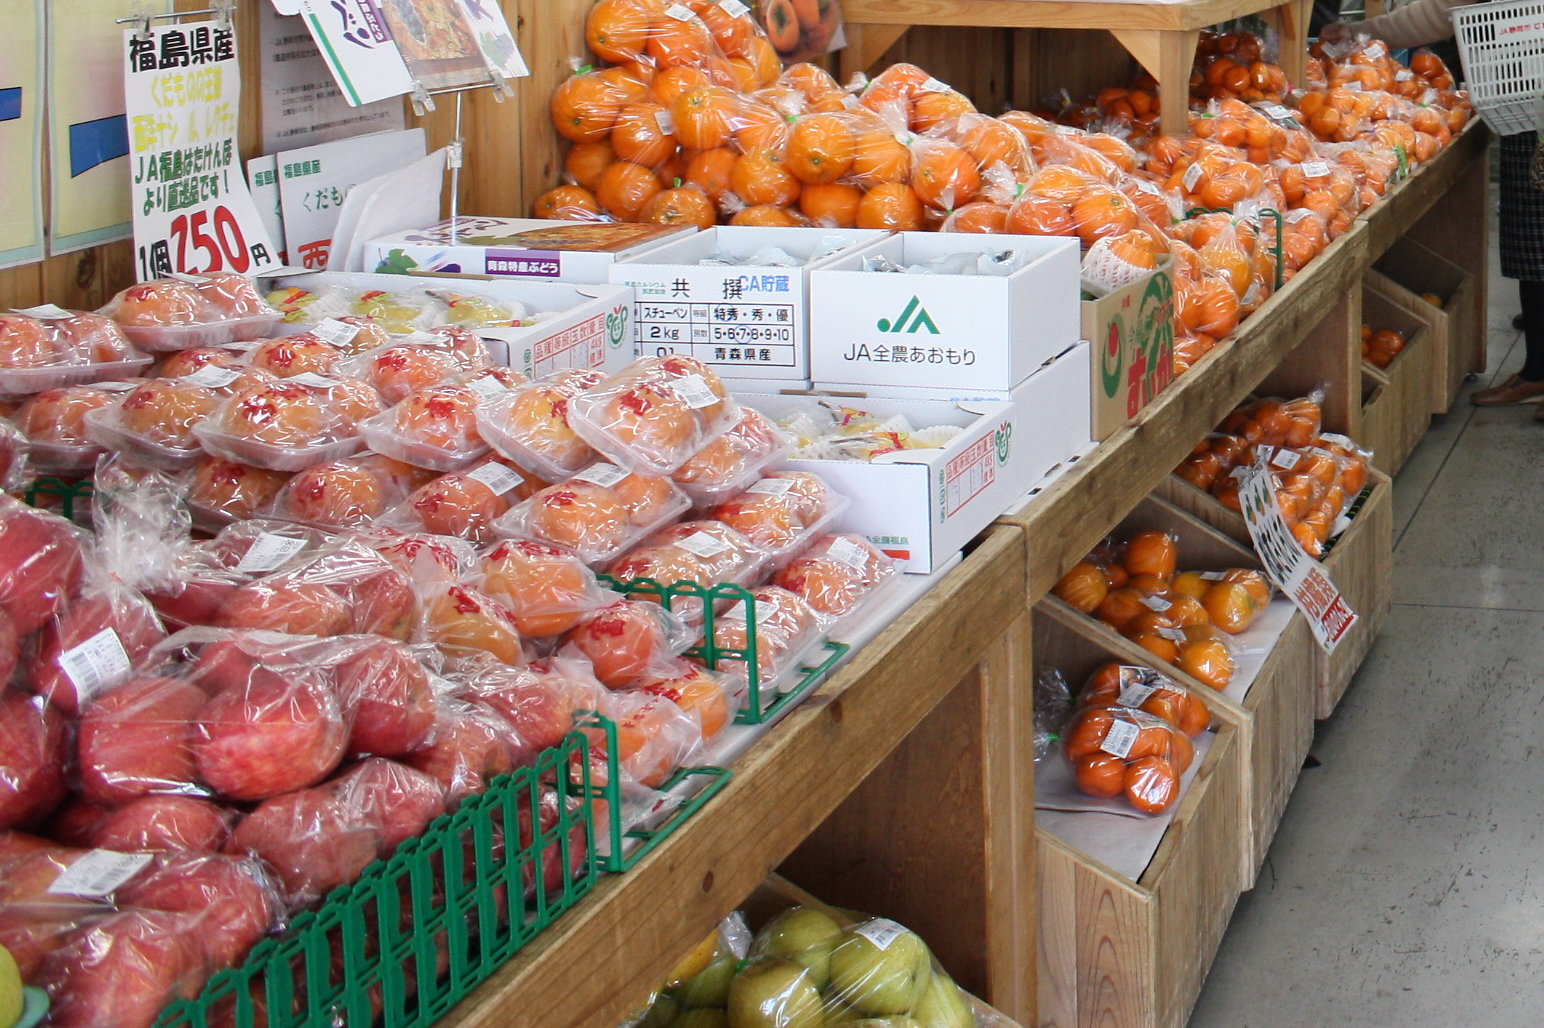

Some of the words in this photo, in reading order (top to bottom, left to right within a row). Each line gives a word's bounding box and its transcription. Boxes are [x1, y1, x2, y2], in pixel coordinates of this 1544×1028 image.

[130, 26, 234, 72] 福島県産
[284, 160, 321, 179] 福島県産
[303, 183, 356, 212] くだも
[171, 205, 250, 275] 250
[250, 243, 271, 267] 円
[487, 260, 558, 274] 青森特産ぶどう
[671, 278, 690, 298] 共
[738, 275, 789, 292] CA貯蔵
[644, 307, 687, 319] スチューベン
[651, 327, 660, 338] 2
[664, 327, 679, 340] kg
[715, 348, 771, 361] 青森県産
[843, 343, 976, 366] JA全農あおもり
